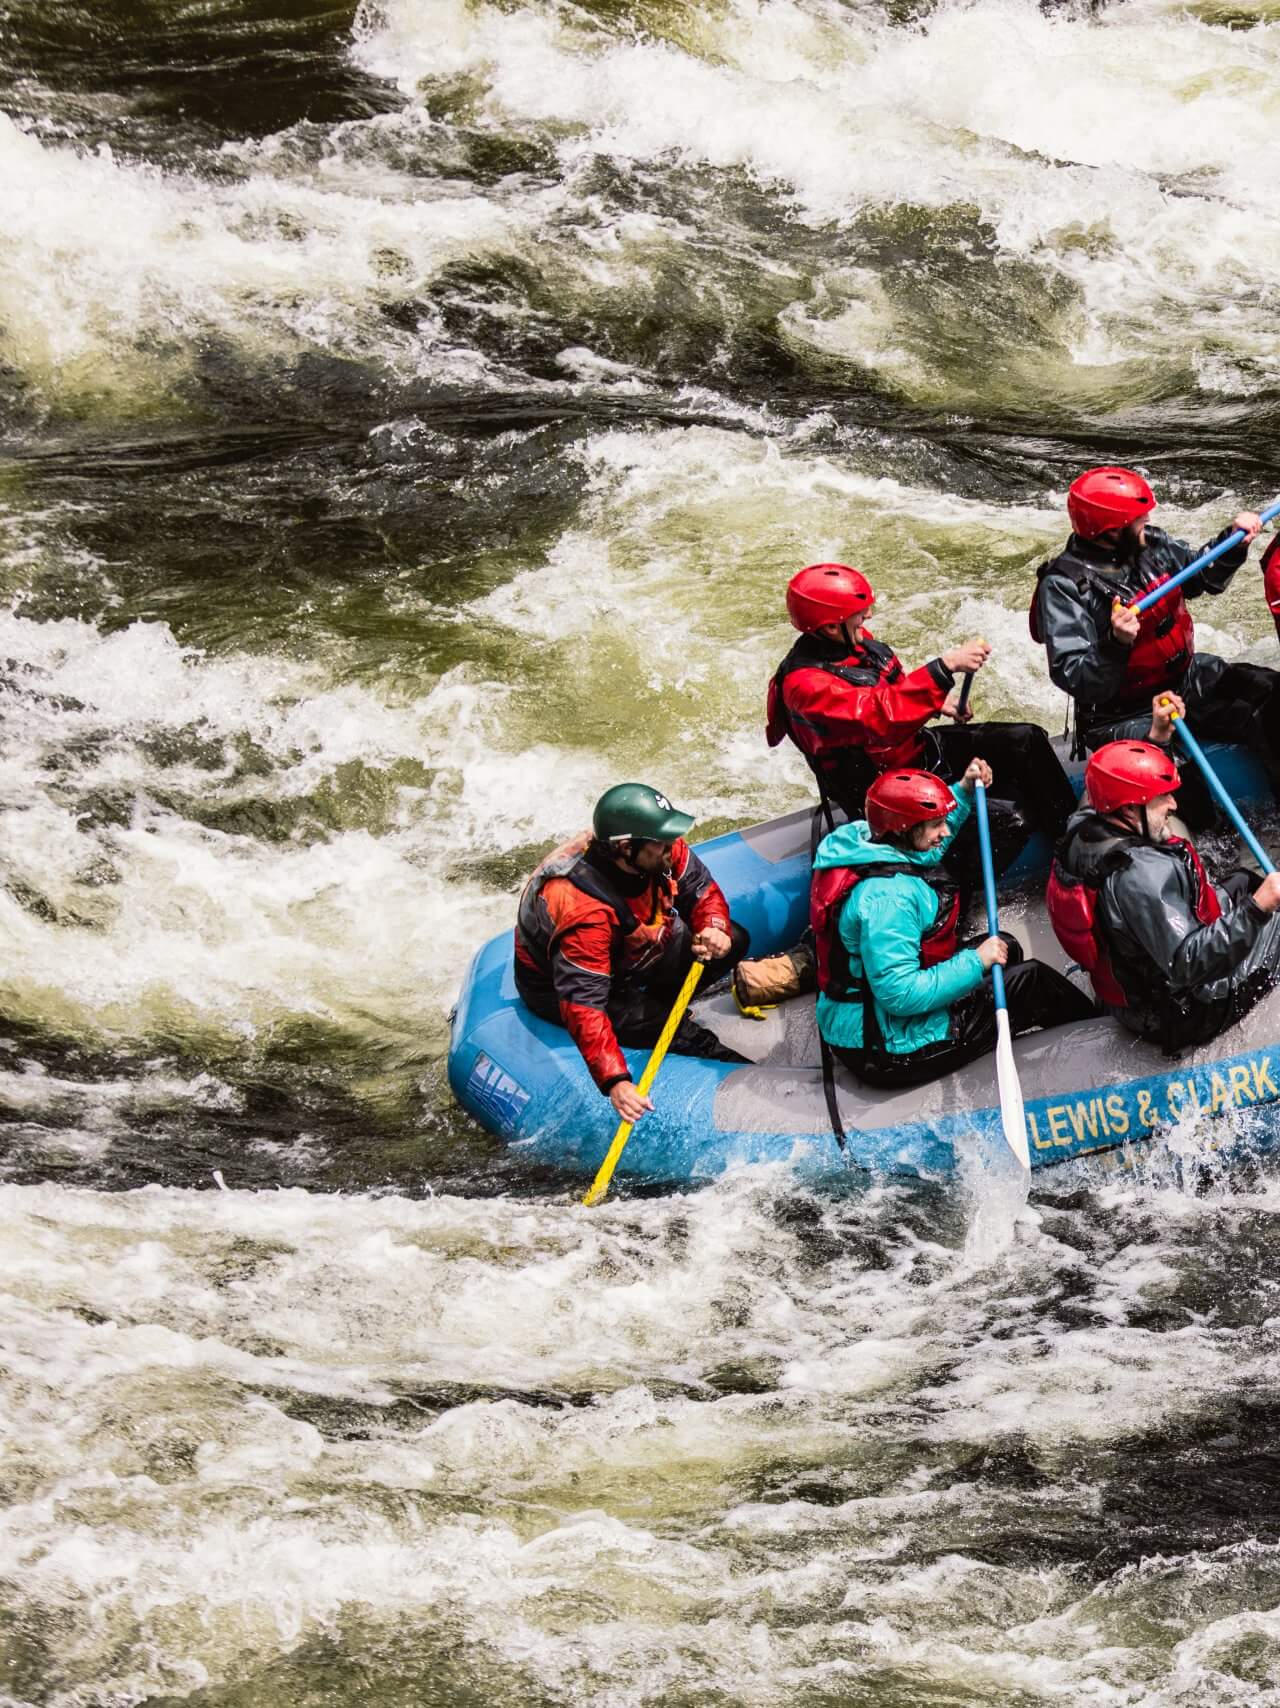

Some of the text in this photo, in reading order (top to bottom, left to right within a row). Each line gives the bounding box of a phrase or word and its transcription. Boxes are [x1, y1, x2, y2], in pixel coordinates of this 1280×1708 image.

[1027, 1056, 1279, 1149] LEWIS & CLARK
